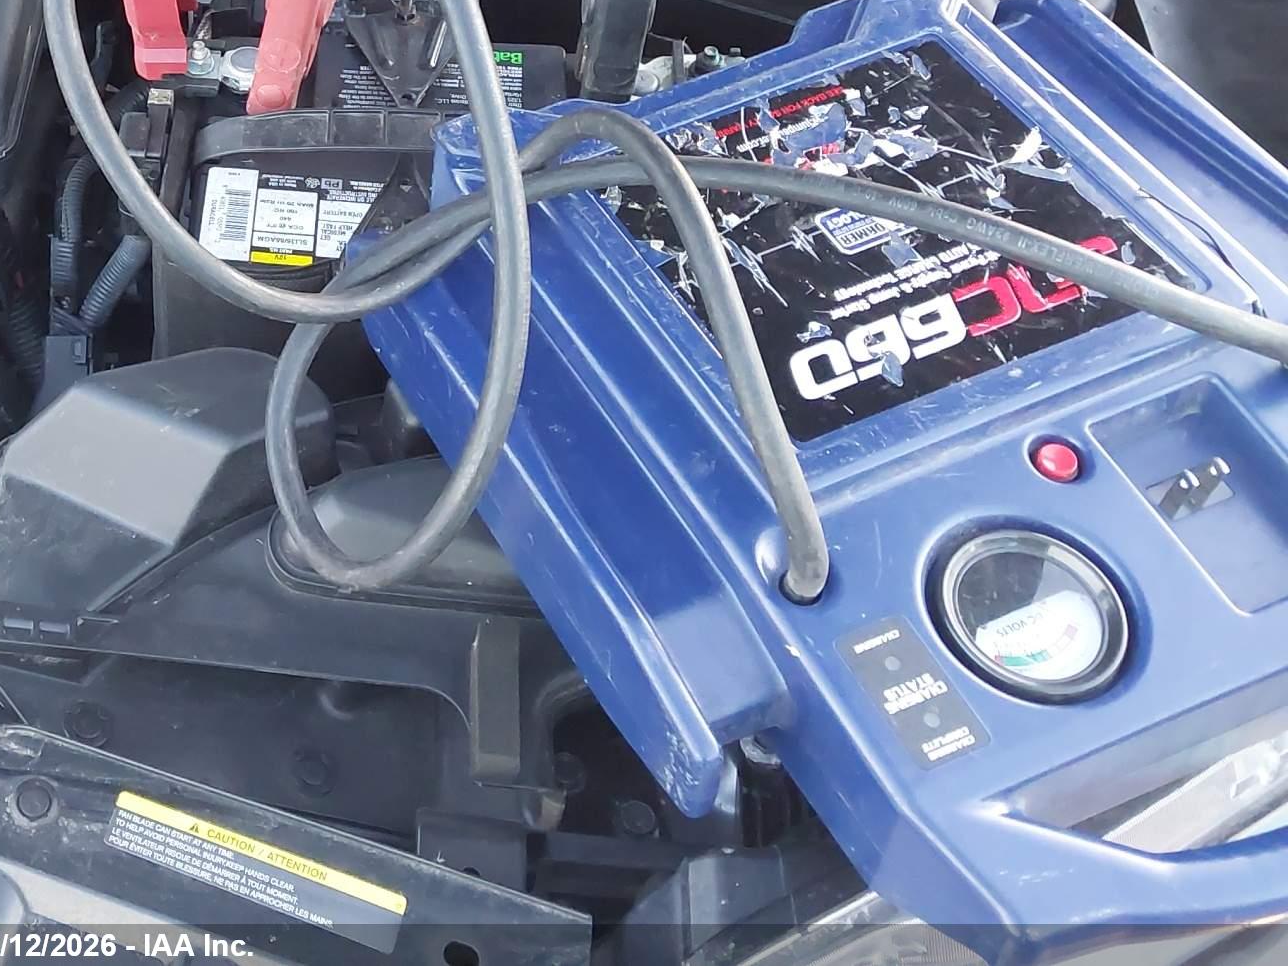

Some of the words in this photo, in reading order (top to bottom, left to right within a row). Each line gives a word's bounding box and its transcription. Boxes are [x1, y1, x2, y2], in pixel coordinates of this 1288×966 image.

[995, 618, 1028, 639] VOLTS
[883, 671, 935, 702] STATUS
[114, 818, 126, 828] TO
[125, 822, 145, 835] HELP
[143, 829, 166, 843] AVOID
[165, 837, 203, 857] PERSONAL
[244, 867, 270, 883] HANDS
[269, 877, 297, 893] CLEAR.
[117, 810, 133, 821] FAN
[132, 815, 156, 830] BLADE
[155, 824, 172, 836] CAN
[170, 829, 193, 844] START
[192, 838, 203, 848] AT
[202, 842, 218, 853] ANY
[206, 828, 256, 853] CAUTION
[266, 851, 328, 881] ATTENTION
[108, 835, 130, 849] POUR
[128, 842, 154, 858] ÉVITER
[152, 852, 176, 867] TOUTE
[213, 875, 226, 886] NE
[224, 880, 240, 891] PAS
[239, 885, 251, 896] EN
[249, 890, 295, 913] APPROCHER
[294, 907, 310, 919] LES
[111, 827, 122, 836] LE
[120, 830, 165, 853] VENTILATEUR
[164, 847, 191, 863] RISQUE
[190, 857, 203, 868] DE
[201, 860, 241, 882] DÉMARRER
[246, 879, 267, 892] TOUT
[265, 886, 300, 905] MOMENT.
